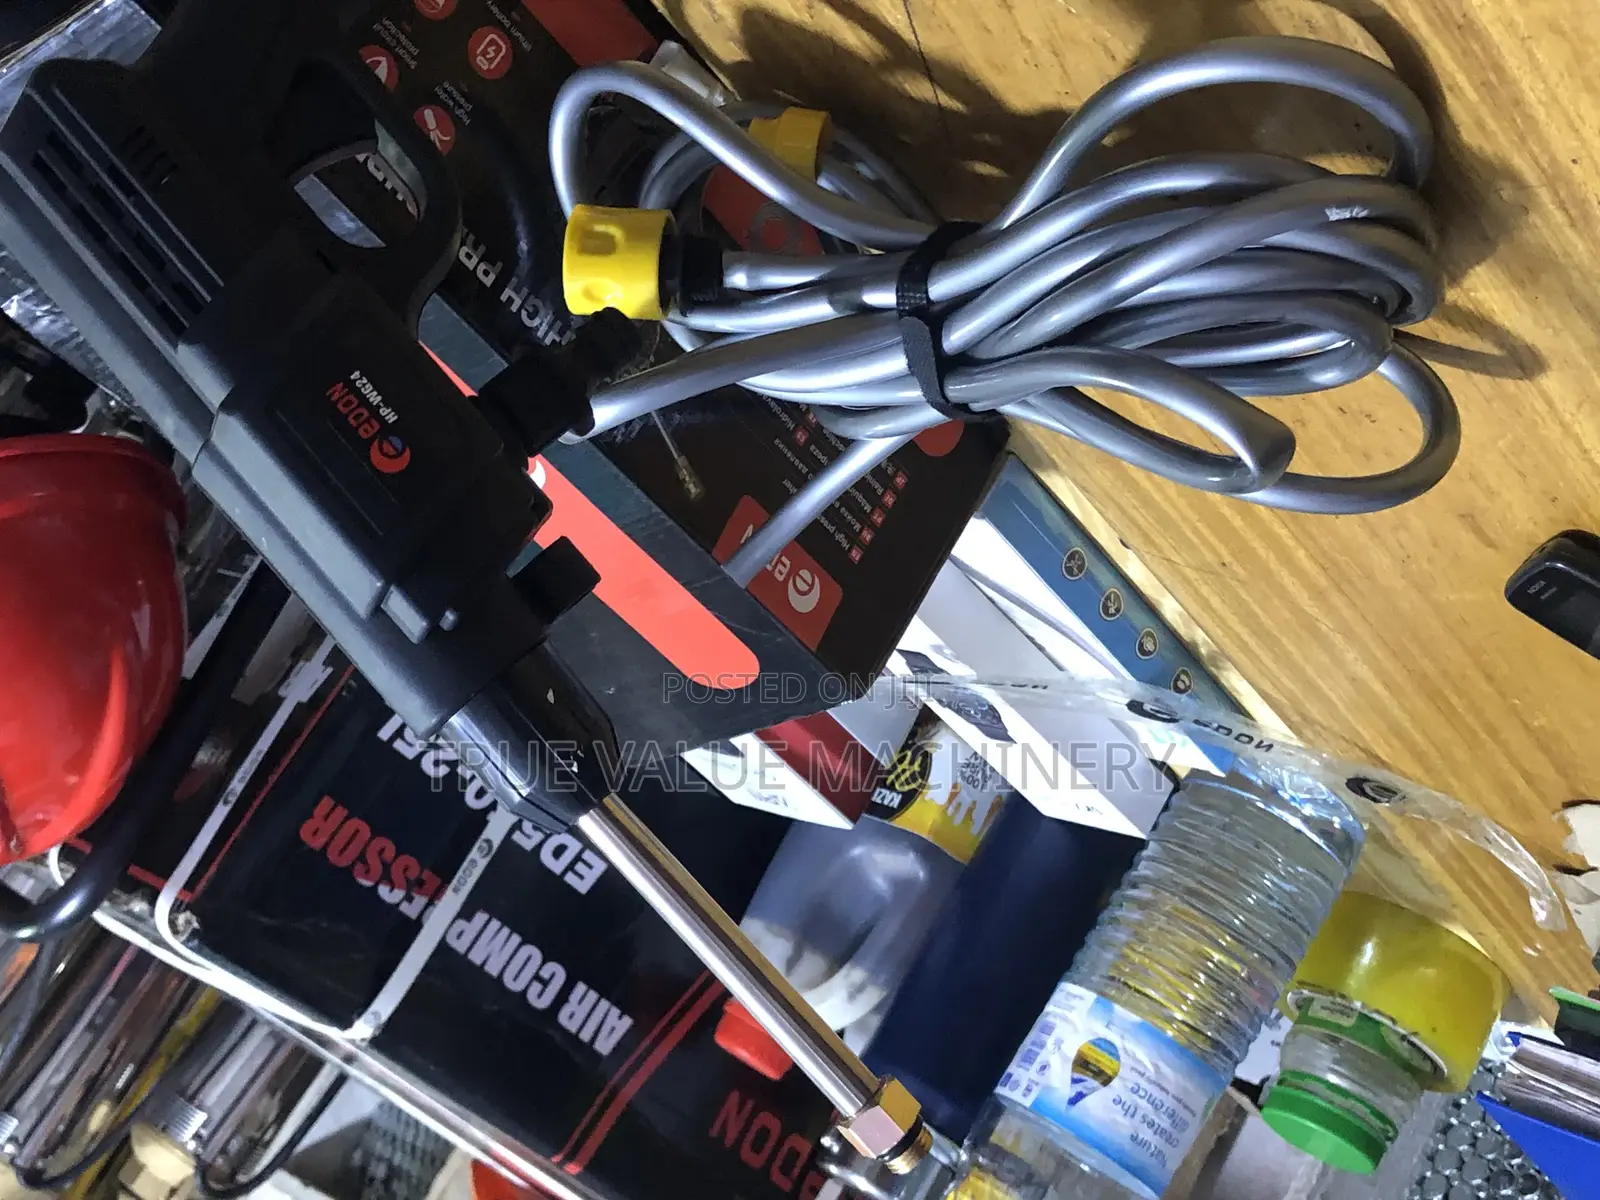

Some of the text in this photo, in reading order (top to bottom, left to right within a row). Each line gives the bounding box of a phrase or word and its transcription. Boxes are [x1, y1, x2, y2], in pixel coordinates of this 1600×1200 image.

[434, 86, 471, 127] High water
[350, 370, 398, 424] HP-WG24
[871, 786, 903, 809] KAZI
[557, 981, 634, 1056] AIR
[1111, 1093, 1180, 1150] creates the
